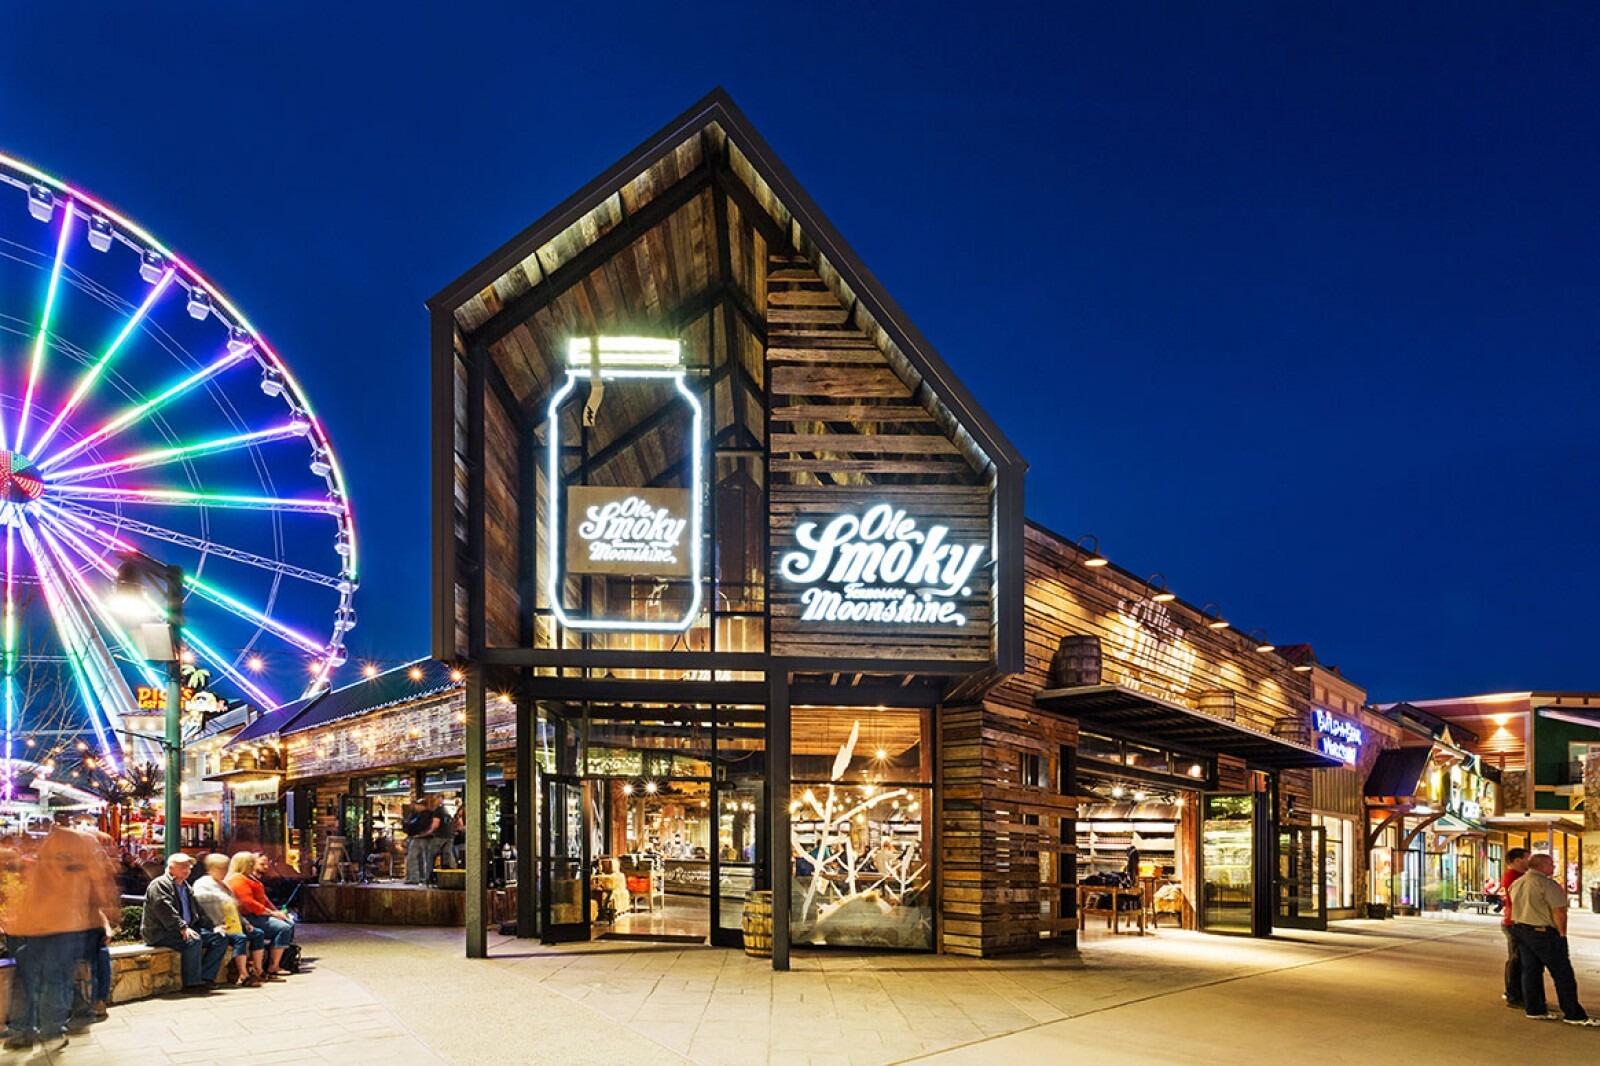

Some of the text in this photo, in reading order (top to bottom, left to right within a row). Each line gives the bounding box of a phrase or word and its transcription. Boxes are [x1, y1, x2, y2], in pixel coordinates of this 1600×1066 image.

[579, 502, 687, 548] Smoky
[620, 496, 655, 519] Ole
[859, 504, 925, 544] Ole
[781, 514, 985, 597] Smoky
[801, 587, 966, 627] Moonshine
